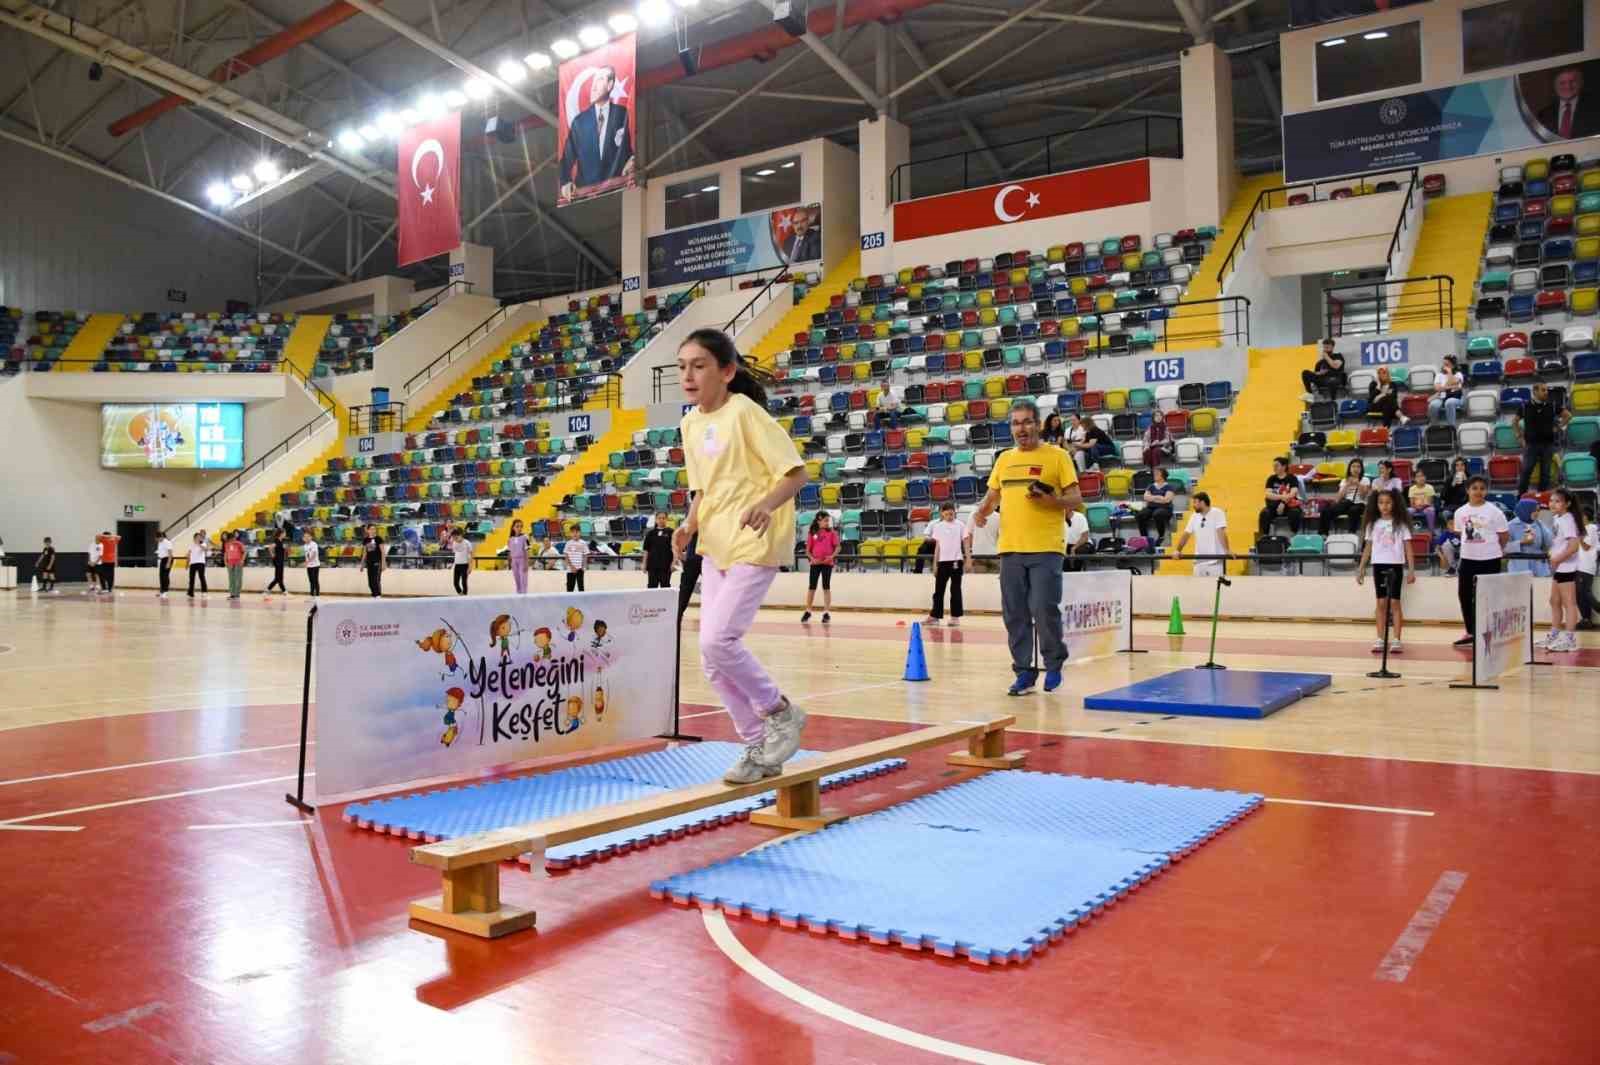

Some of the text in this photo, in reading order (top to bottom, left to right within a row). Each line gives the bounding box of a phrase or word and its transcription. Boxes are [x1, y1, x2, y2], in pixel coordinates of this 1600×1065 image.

[863, 232, 882, 249] 205
[624, 277, 639, 291] 204
[1365, 342, 1402, 364] 106
[1147, 360, 1178, 381] 105
[571, 416, 588, 431] 104
[360, 439, 373, 451] 104
[469, 655, 584, 698] Yeteneğini
[492, 694, 566, 743] Keşfet
